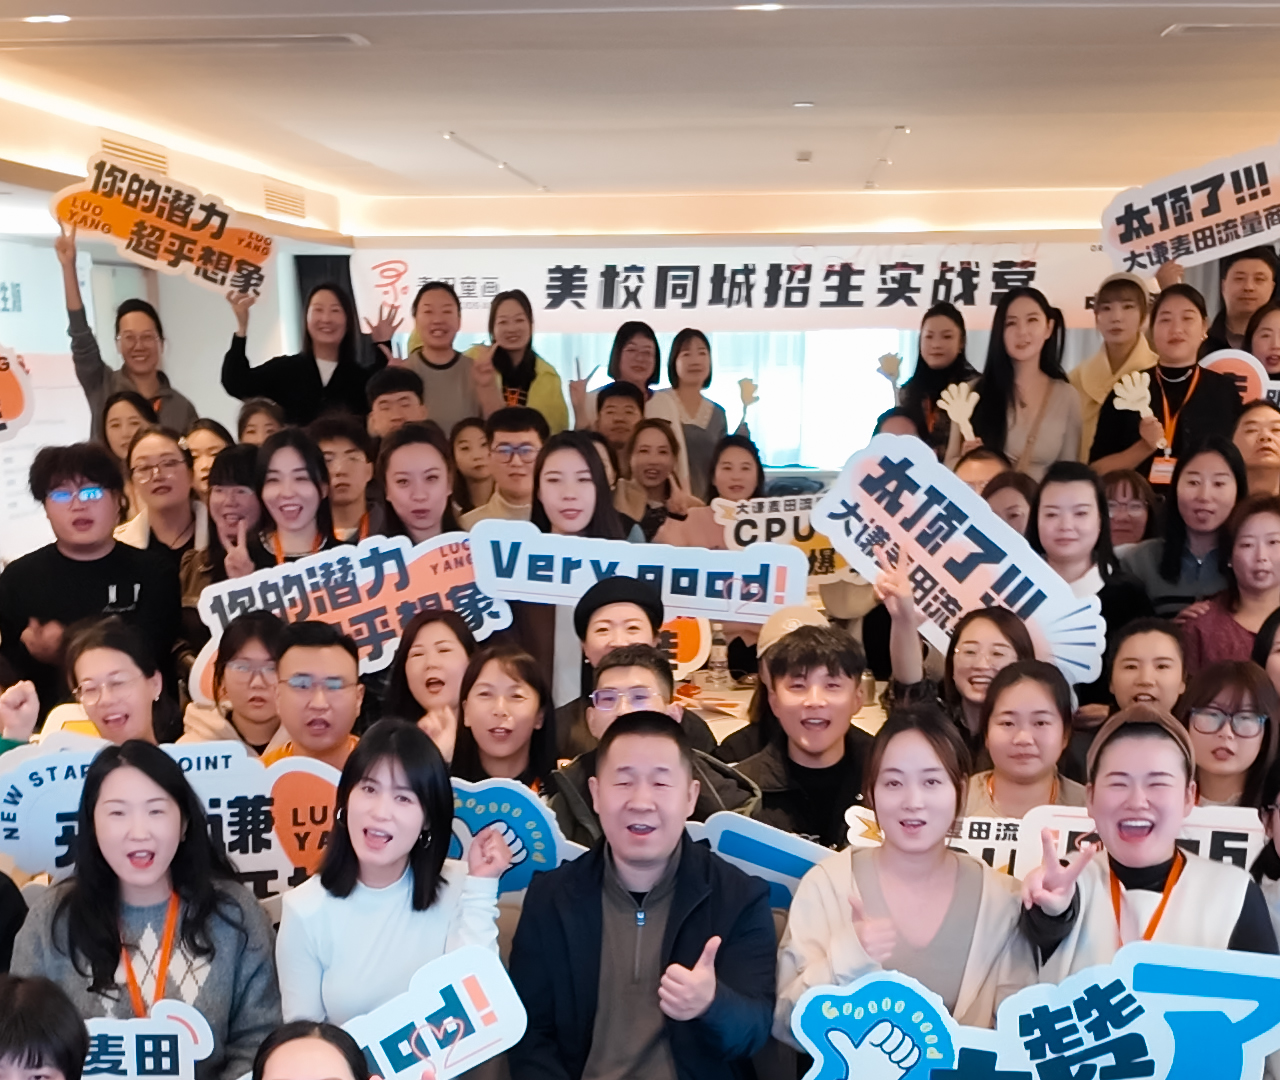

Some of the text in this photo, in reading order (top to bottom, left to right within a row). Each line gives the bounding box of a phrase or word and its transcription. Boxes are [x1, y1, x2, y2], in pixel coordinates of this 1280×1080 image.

[68, 209, 113, 234] YANG
[71, 197, 104, 217] LUO
[90, 160, 230, 240] 你的潜力
[1115, 161, 1271, 244] 太顶了!!!
[125, 219, 265, 297] 超乎想象
[544, 261, 1038, 310] 美校同城招生实战营
[734, 516, 816, 547] CPU
[736, 496, 825, 515] 大谦麦田流
[210, 546, 411, 632] 你的潜力
[489, 540, 788, 605] Very good!
[827, 499, 964, 637] 大谦田流
[0, 784, 24, 840] NEW
[179, 755, 233, 773] OINT
[292, 805, 328, 827] LU
[362, 973, 498, 1080] od!
